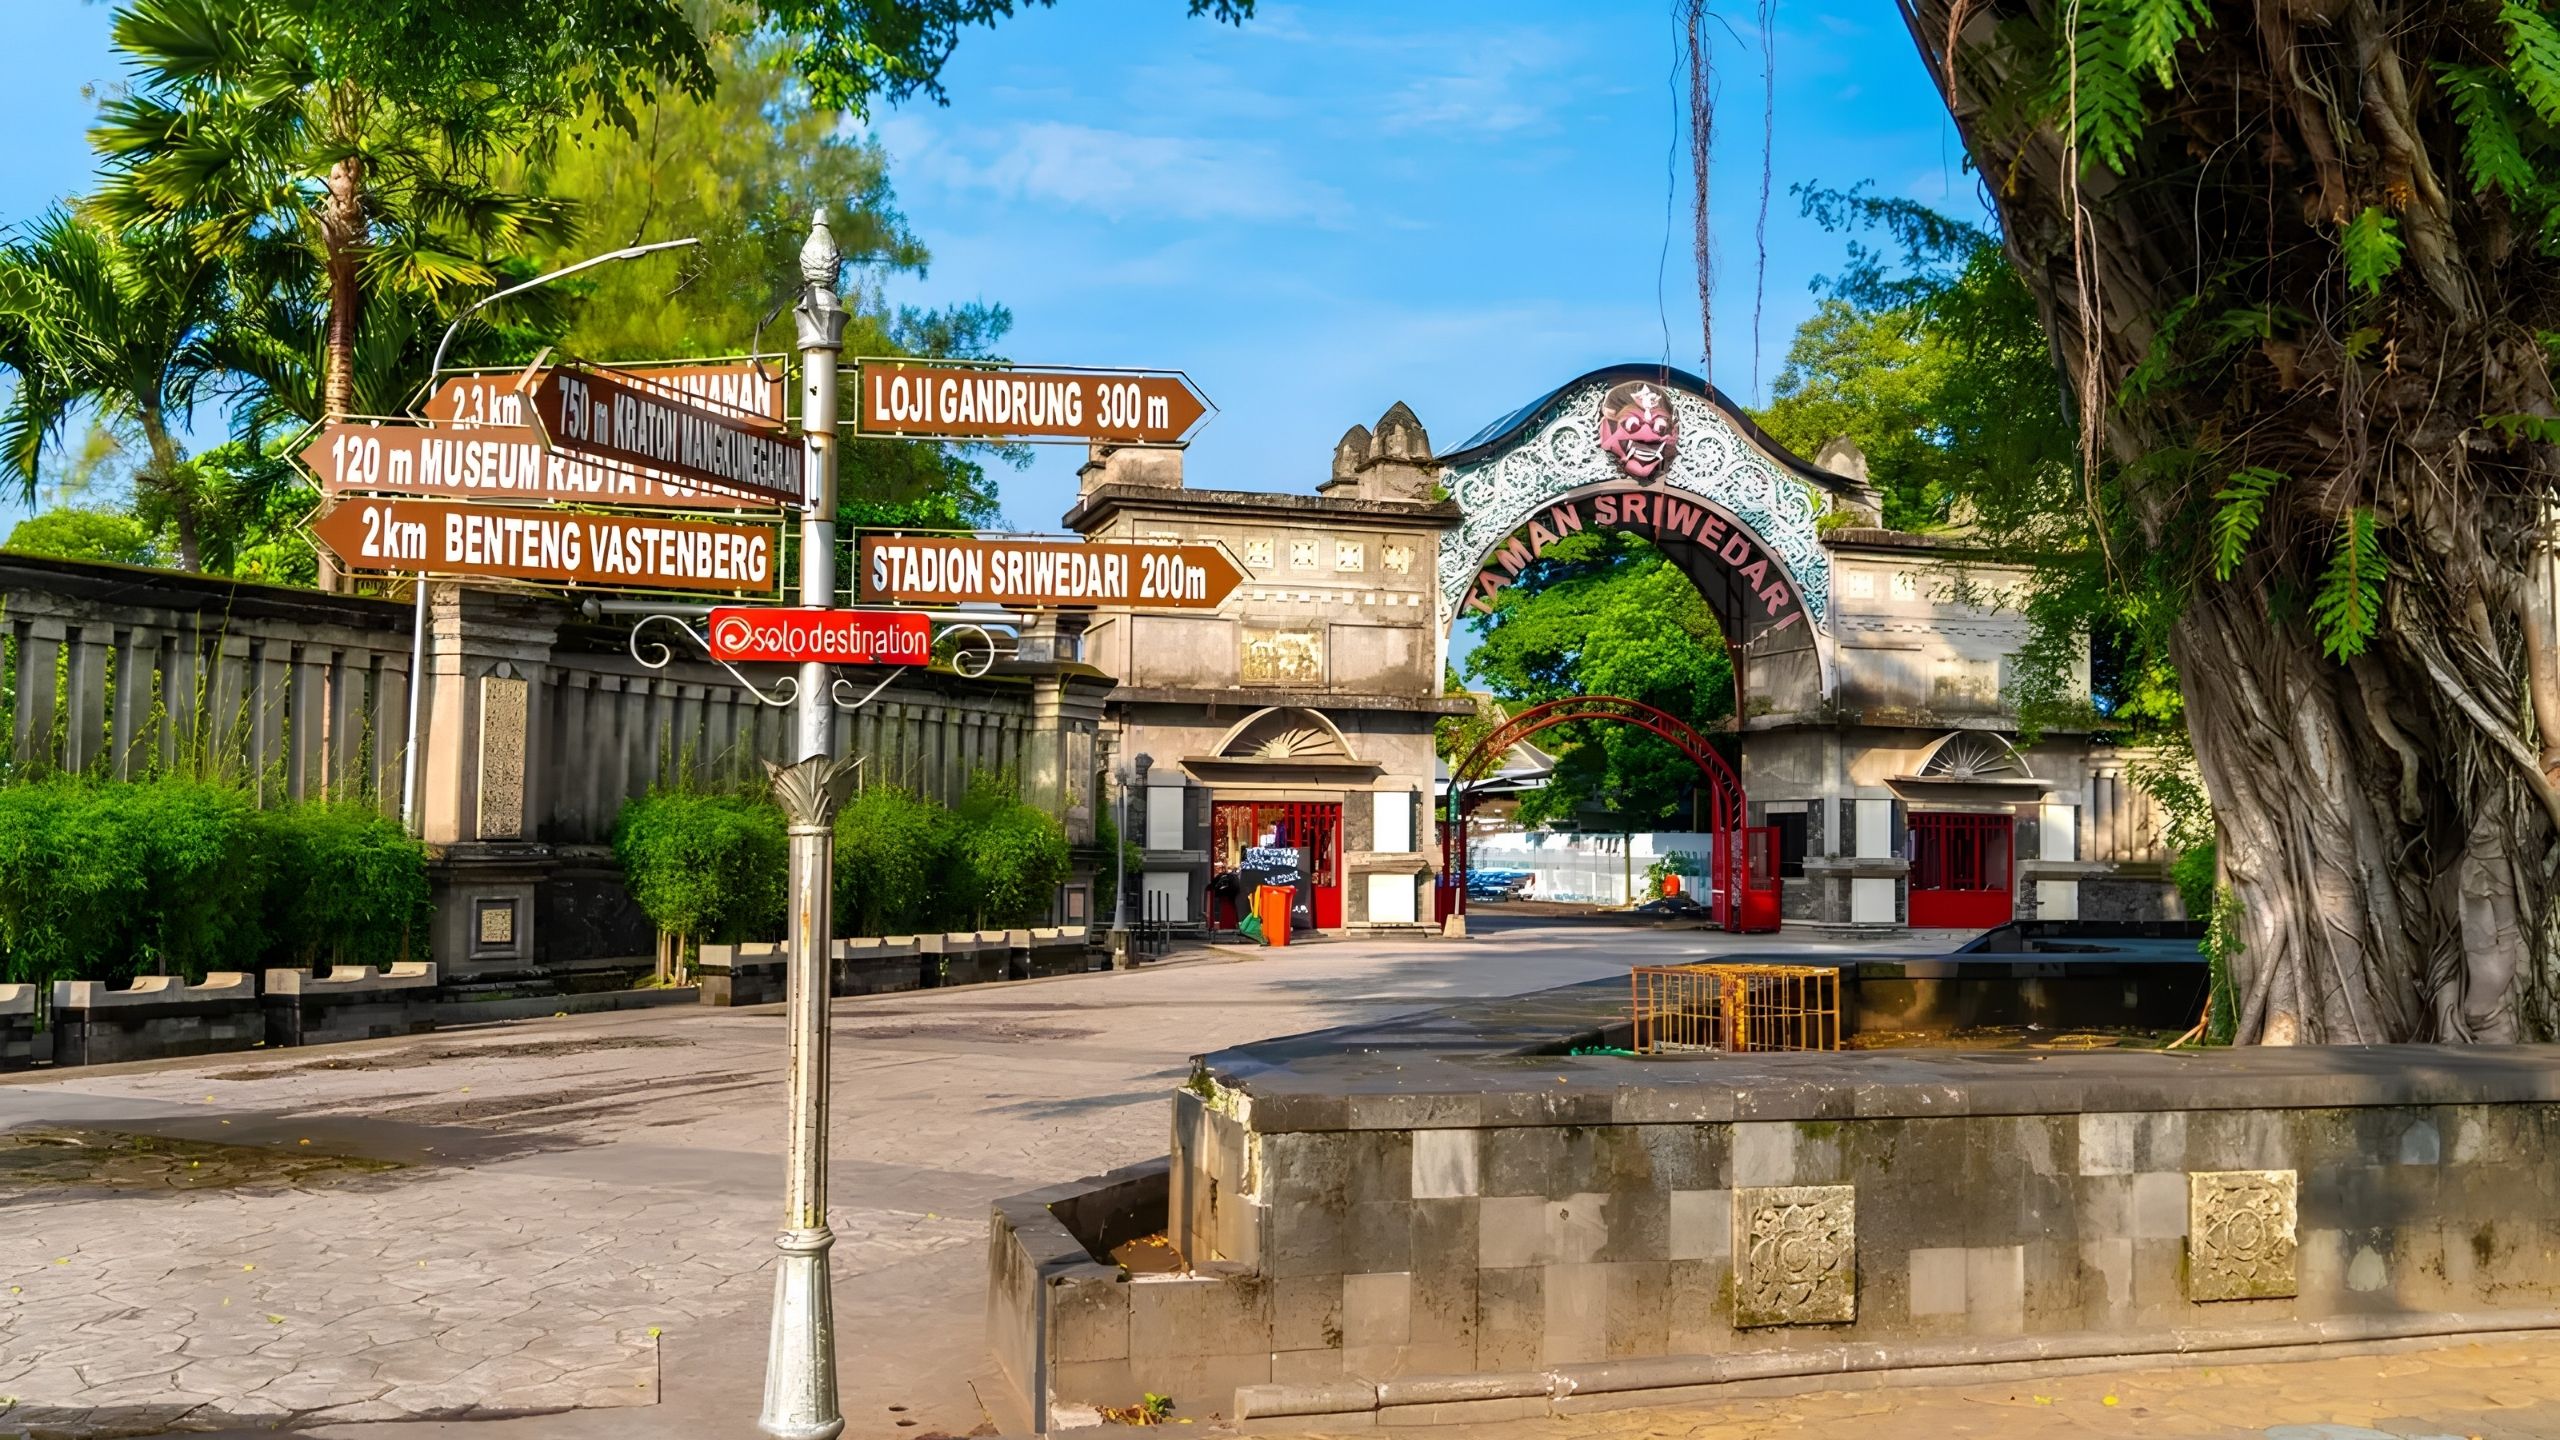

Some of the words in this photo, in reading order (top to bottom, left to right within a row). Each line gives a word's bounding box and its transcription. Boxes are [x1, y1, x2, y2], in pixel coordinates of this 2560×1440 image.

[489, 384, 522, 426] km
[558, 375, 589, 441] 750
[593, 400, 609, 446] m
[613, 392, 678, 462] KRATON
[874, 374, 932, 422] LOJI
[939, 377, 1083, 428] GANDRUNG
[1096, 382, 1141, 430] 300
[1147, 393, 1169, 430] m
[332, 433, 381, 484] 120
[387, 448, 413, 485] m
[419, 438, 541, 490] MUSEUM
[445, 513, 581, 571] BENTENG
[588, 524, 766, 582] VASTENBERG
[872, 544, 983, 596] STADION
[989, 548, 1128, 599] SRIWEDARI
[1140, 552, 1207, 600] 200m
[1465, 501, 1583, 615] TAMAN
[1594, 492, 1802, 631] SRIWEDARI
[754, 620, 806, 657] solo
[808, 621, 928, 654] destination
